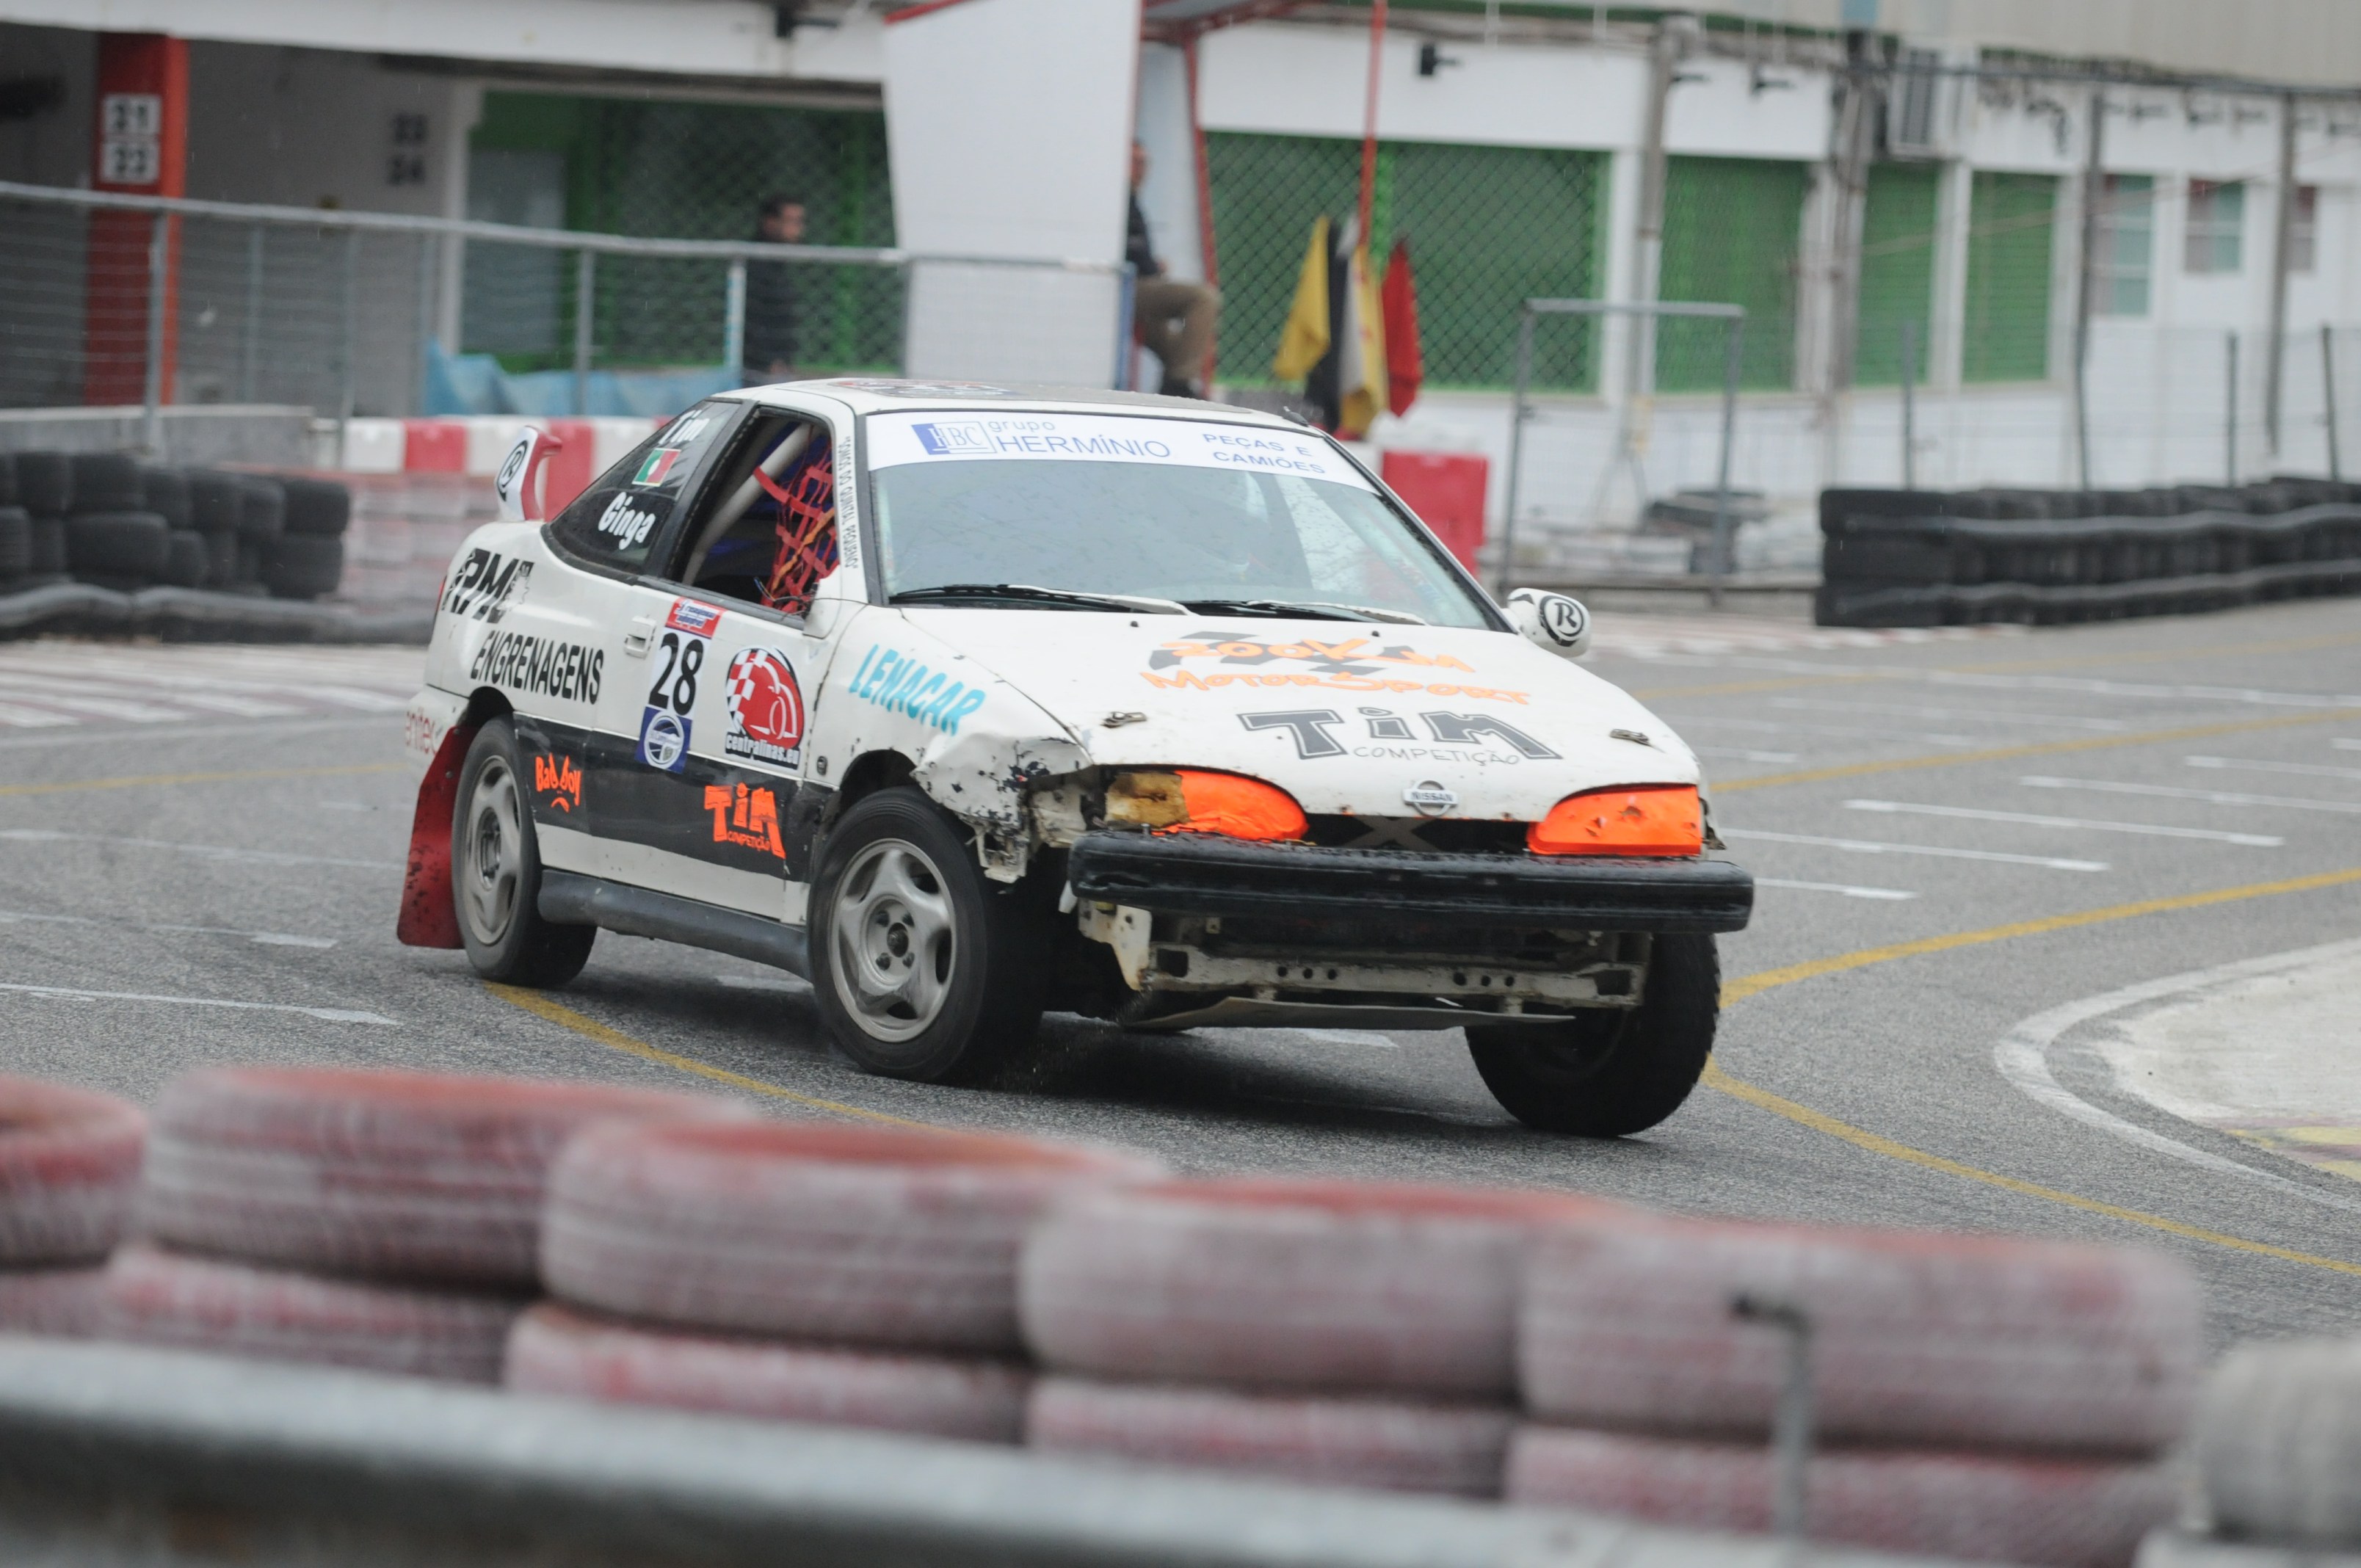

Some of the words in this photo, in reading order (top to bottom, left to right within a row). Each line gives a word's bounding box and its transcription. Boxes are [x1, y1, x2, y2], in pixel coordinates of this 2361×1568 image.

[988, 421, 1055, 432] grupo
[995, 434, 1169, 457] HERMÍNIO
[1202, 433, 1285, 451] PEÇAS
[1295, 446, 1313, 457] E
[1213, 451, 1326, 473] CAMIÕES
[598, 492, 656, 550] Ginga
[471, 631, 603, 705] ENGRENAGENS
[649, 632, 704, 716] 28
[848, 644, 986, 736] LENACAR
[1352, 746, 1521, 766] COMPETIÇÃO
[1411, 791, 1454, 802] NISSAN
